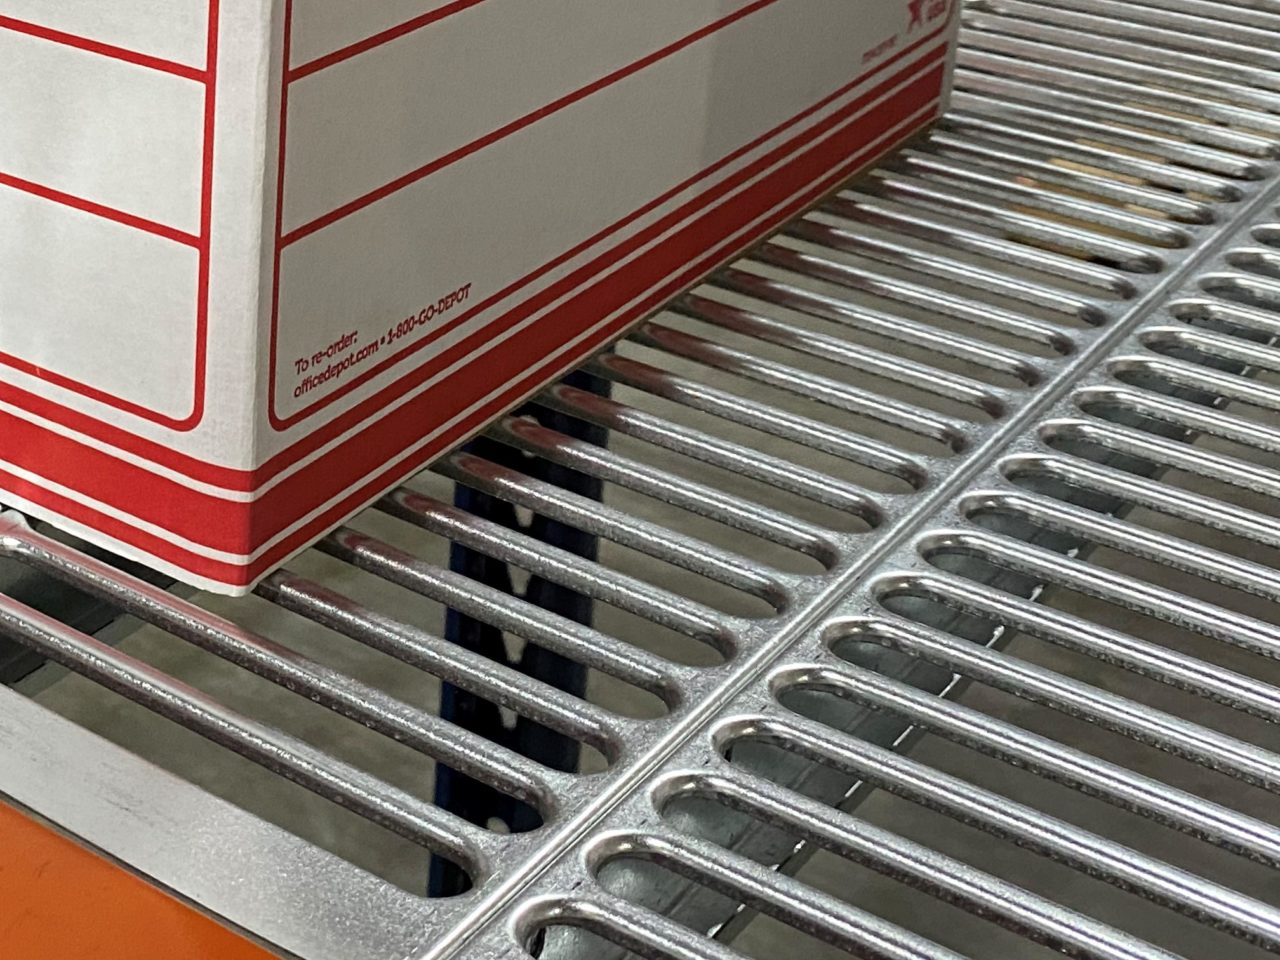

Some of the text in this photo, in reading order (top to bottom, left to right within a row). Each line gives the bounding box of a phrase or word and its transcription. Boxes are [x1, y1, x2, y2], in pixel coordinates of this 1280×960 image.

[293, 283, 472, 399] officedepot.com 1-800-GO-DEPOT
[294, 330, 359, 376] To re-order:
